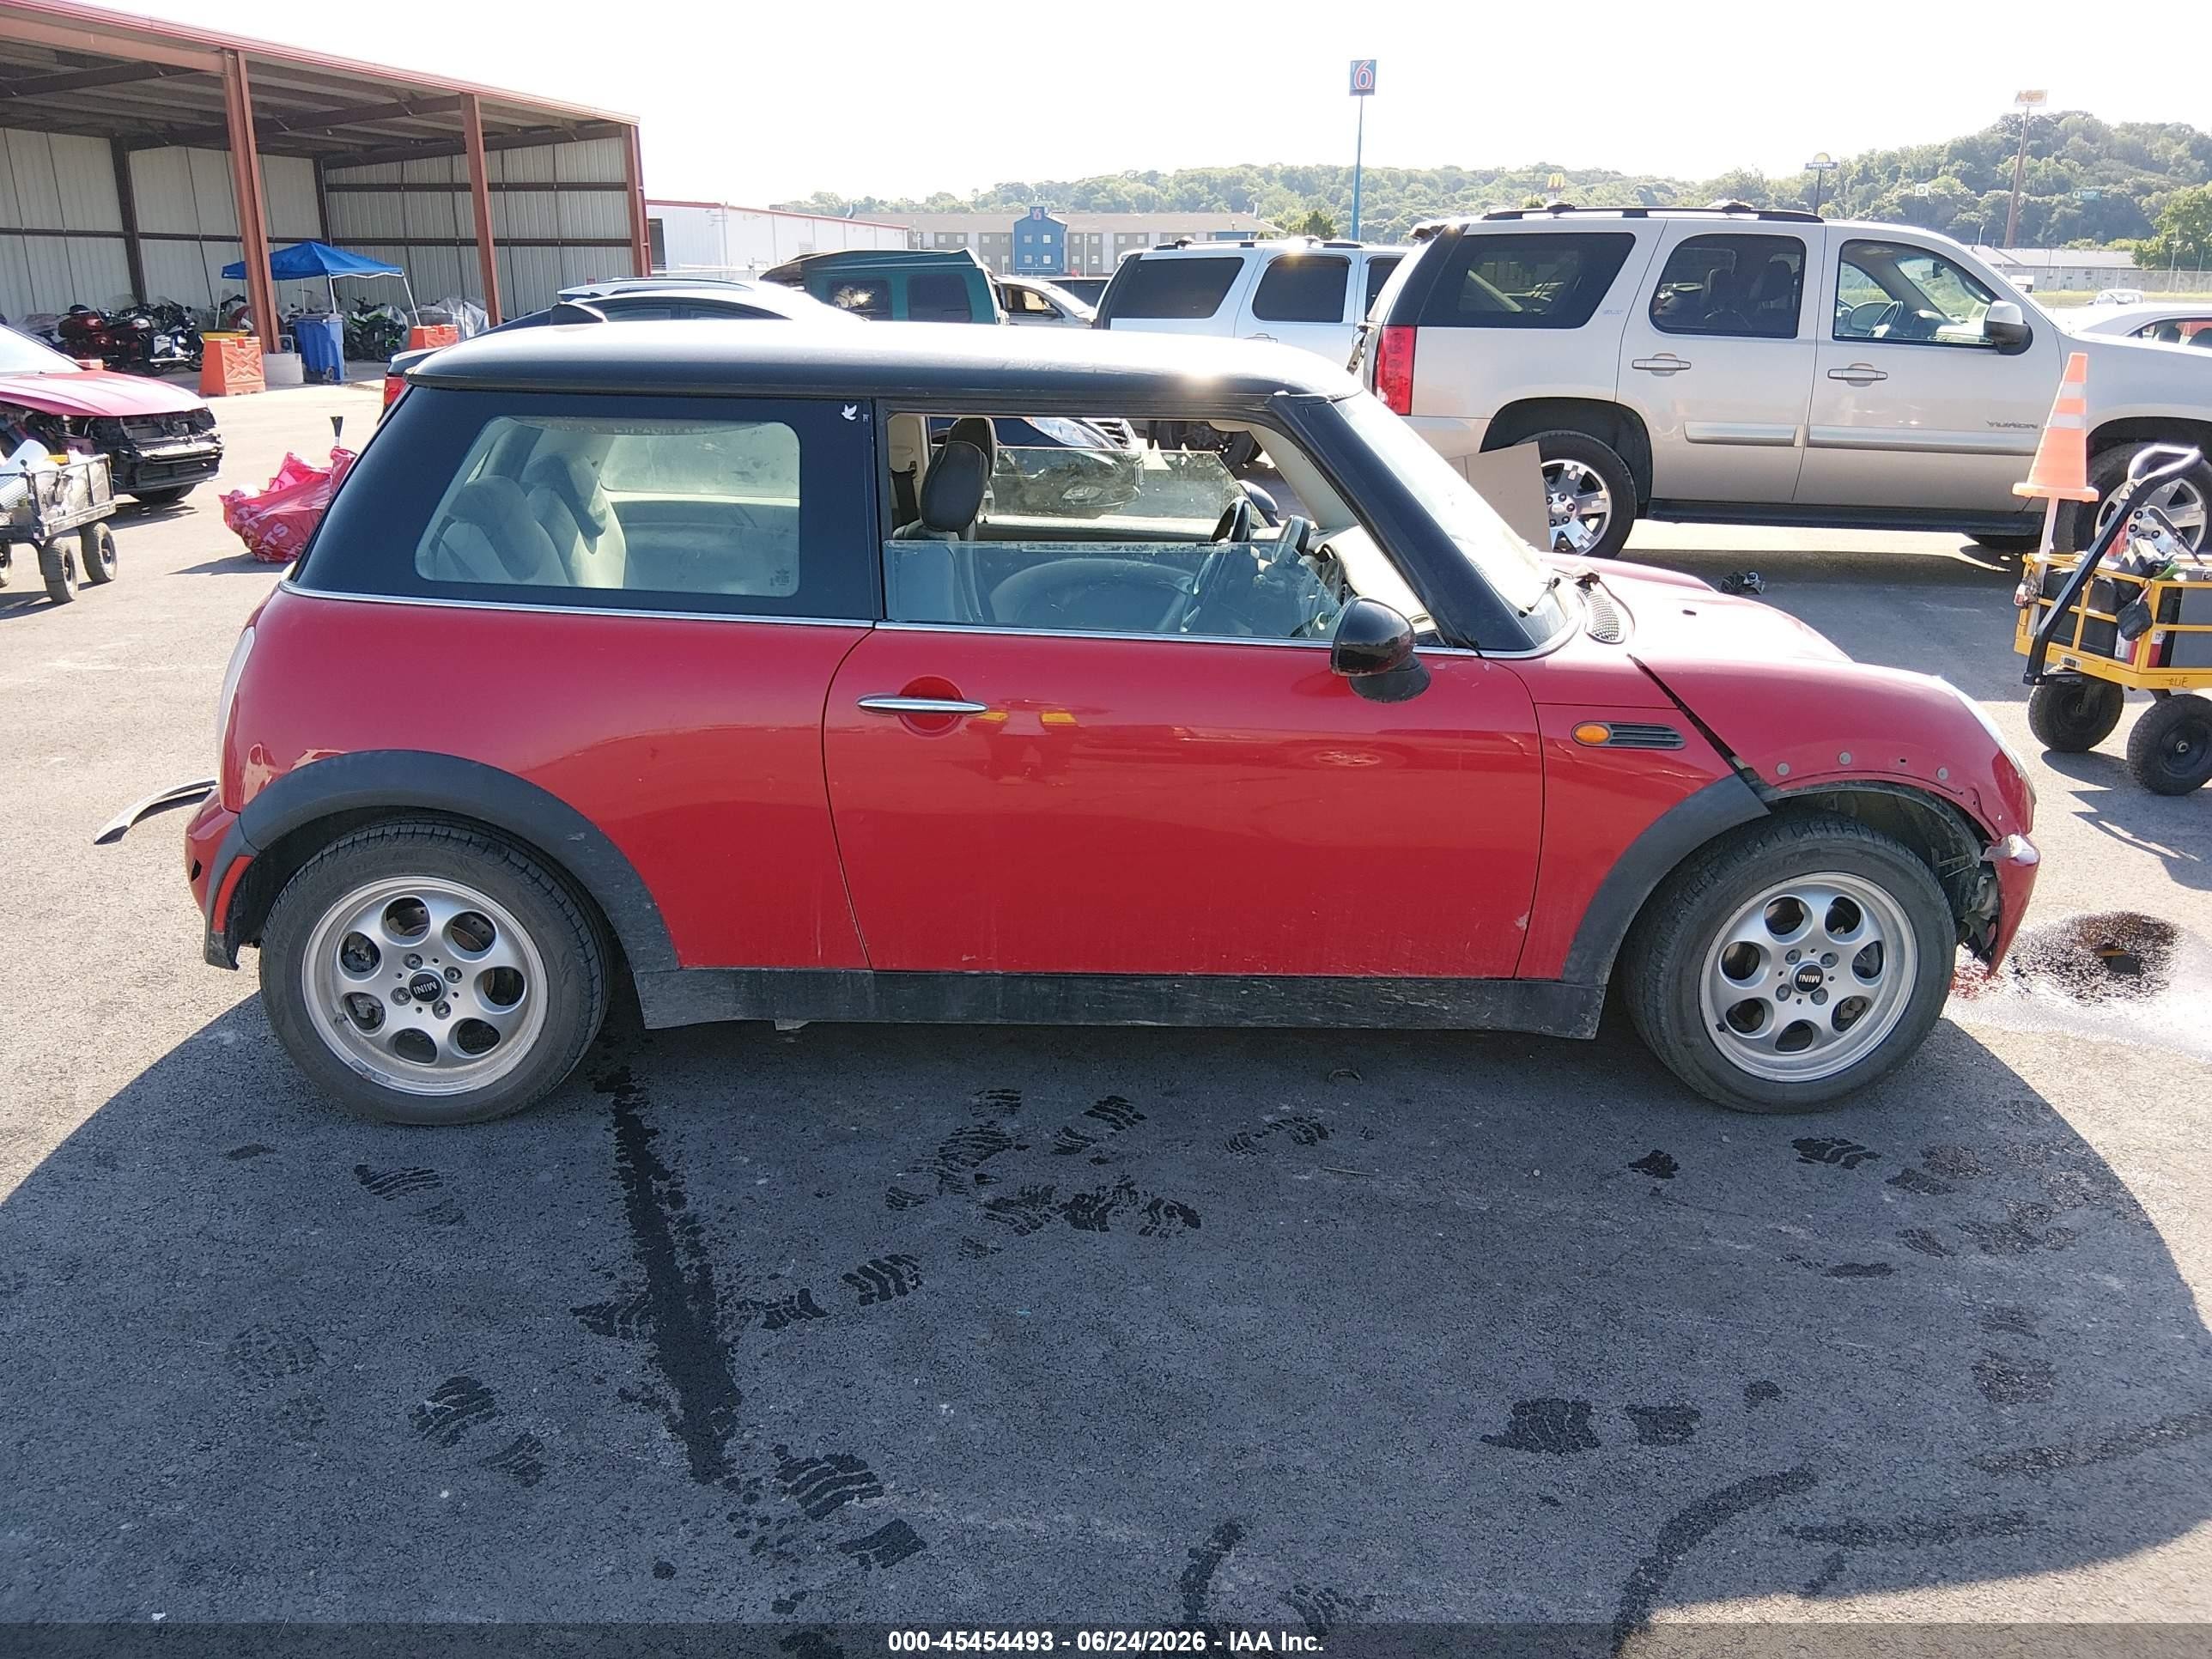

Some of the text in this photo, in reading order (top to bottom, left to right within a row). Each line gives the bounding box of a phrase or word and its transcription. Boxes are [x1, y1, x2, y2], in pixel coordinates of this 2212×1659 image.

[1353, 60, 1374, 90] 6
[1798, 974, 1820, 983] MINI
[413, 981, 437, 995] MINI
